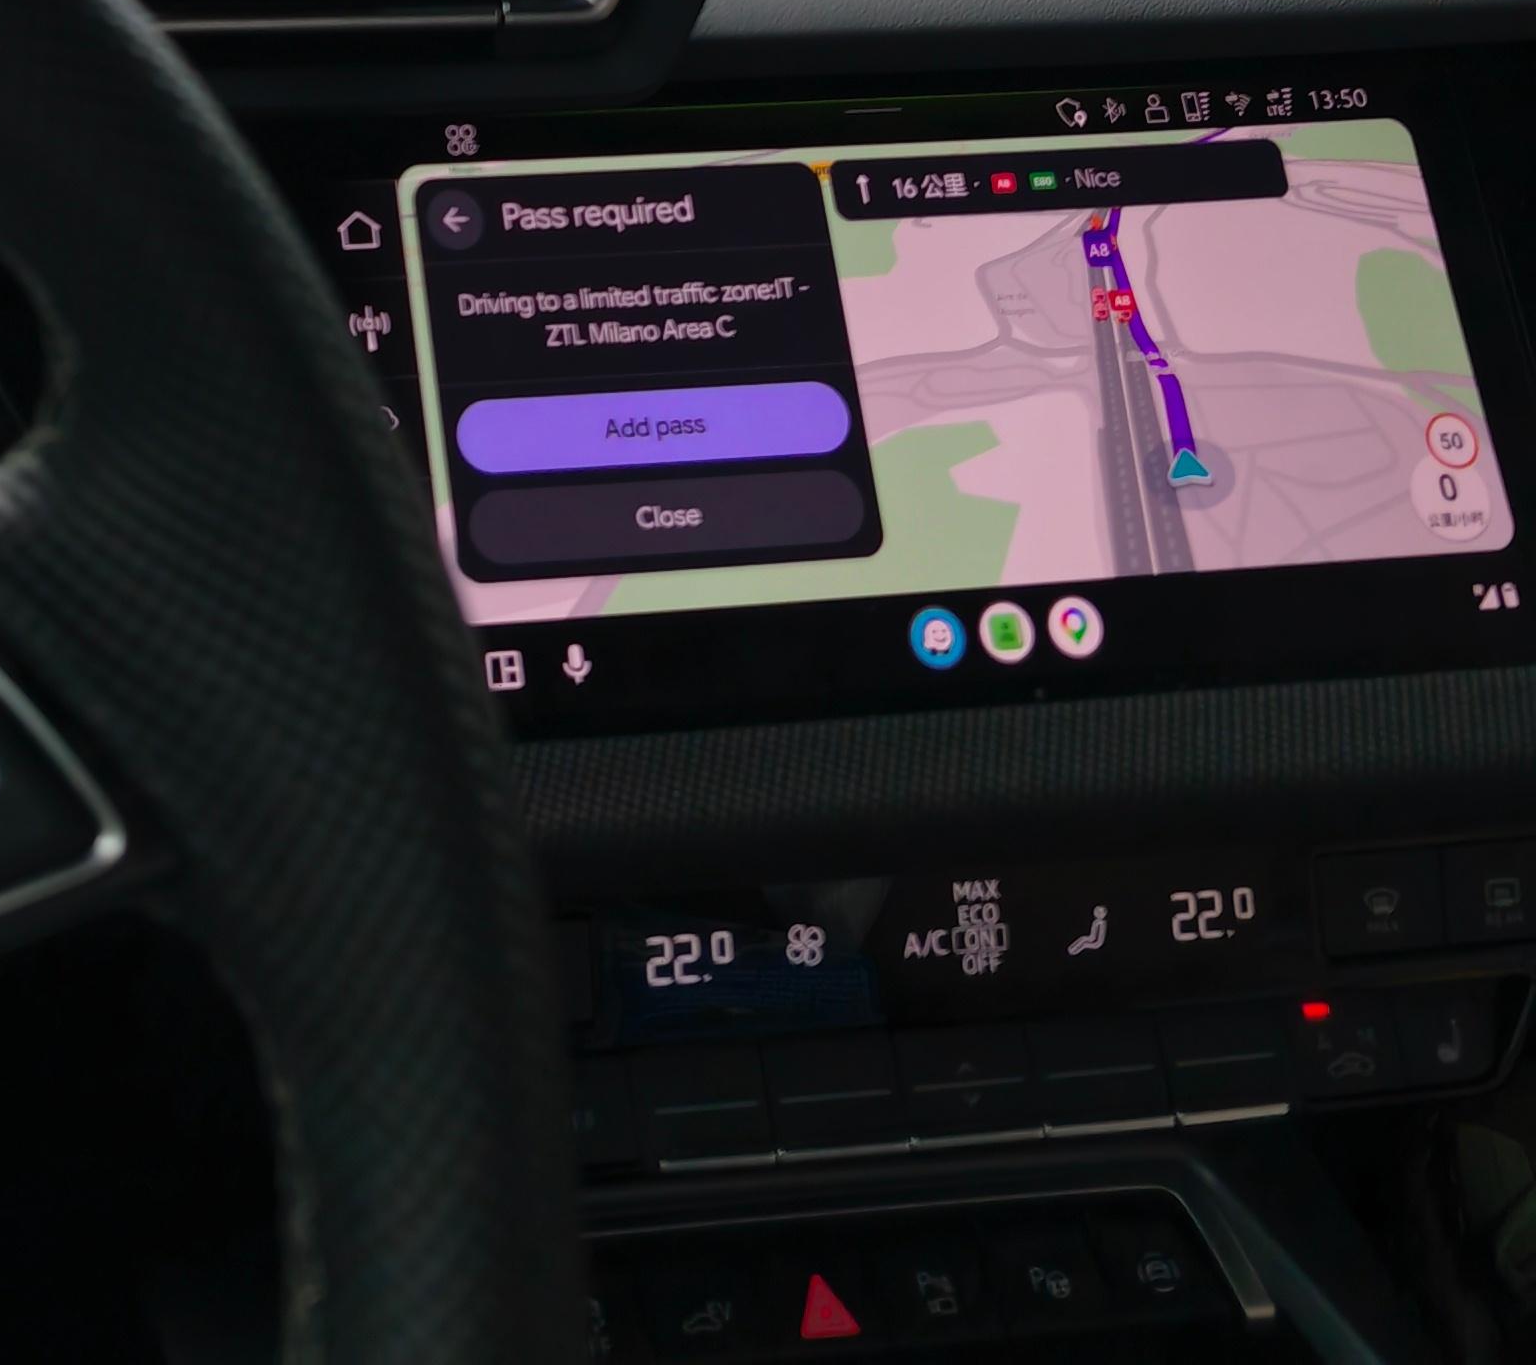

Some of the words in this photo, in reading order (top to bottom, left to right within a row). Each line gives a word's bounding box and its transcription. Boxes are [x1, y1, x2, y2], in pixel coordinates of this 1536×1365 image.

[1267, 105, 1285, 117] LTE
[1308, 88, 1368, 110] 13:50
[891, 176, 919, 200] 16
[920, 171, 970, 199] 公里
[1074, 166, 1122, 190] Nice
[501, 201, 570, 231] Pass
[572, 195, 696, 234] required
[1089, 242, 1111, 258] A8
[457, 292, 535, 319] Driving
[536, 291, 561, 312] to
[563, 294, 580, 311] a
[579, 285, 652, 310] limited
[654, 281, 719, 306] traffic
[544, 323, 588, 348] ZTL
[589, 320, 661, 345] Milano
[662, 319, 715, 342] Area
[715, 314, 738, 338] C
[605, 417, 652, 439] Add
[656, 416, 706, 442] pass
[1439, 432, 1464, 451] 50
[1439, 473, 1458, 502] 0
[635, 503, 704, 530] Close
[952, 879, 1002, 903] MAX
[957, 903, 1000, 926] ECO
[904, 928, 951, 959] A/C
[964, 926, 997, 951] ON
[962, 950, 1004, 976] OFF
